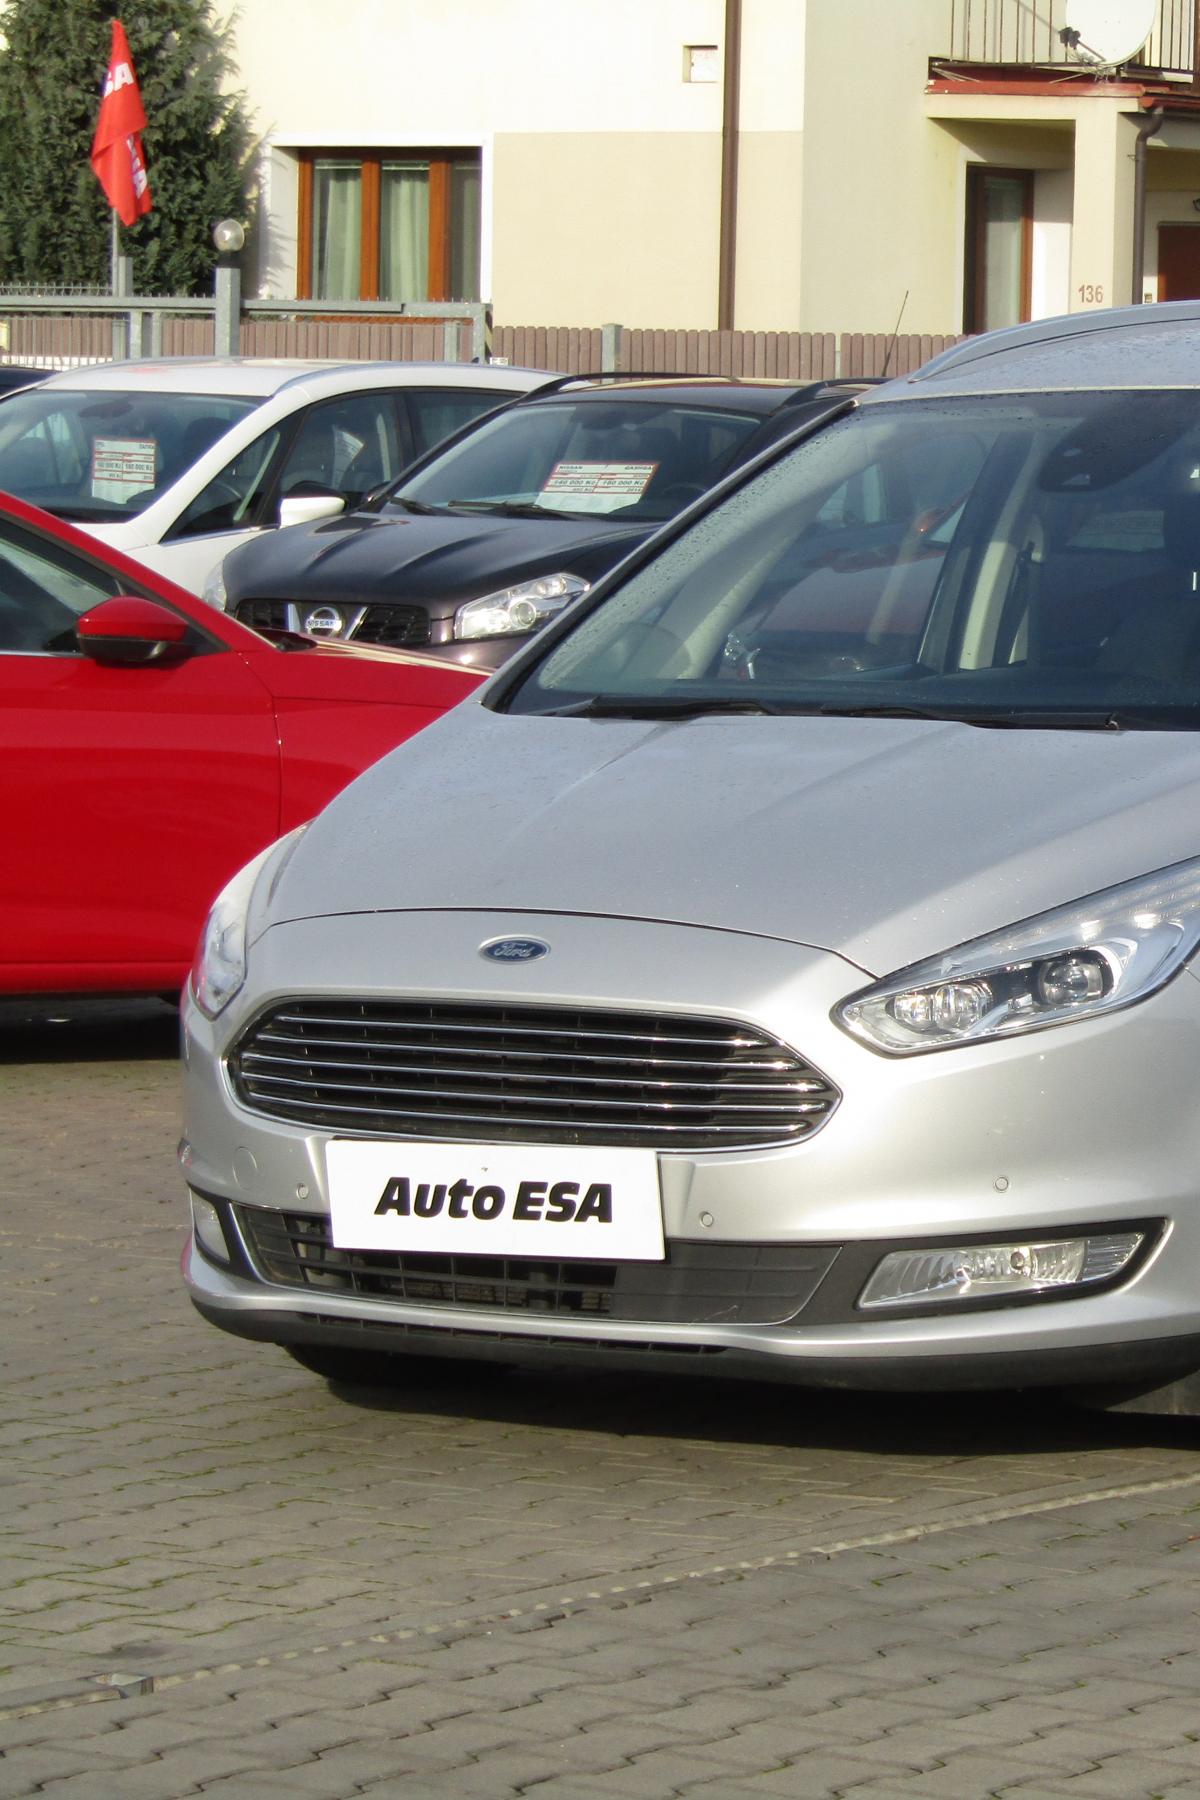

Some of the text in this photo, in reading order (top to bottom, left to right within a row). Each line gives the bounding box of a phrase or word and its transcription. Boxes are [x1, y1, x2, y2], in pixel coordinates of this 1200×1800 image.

[1078, 284, 1104, 304] 136
[493, 941, 536, 957] Ford
[374, 1176, 613, 1223] Auto ESA
